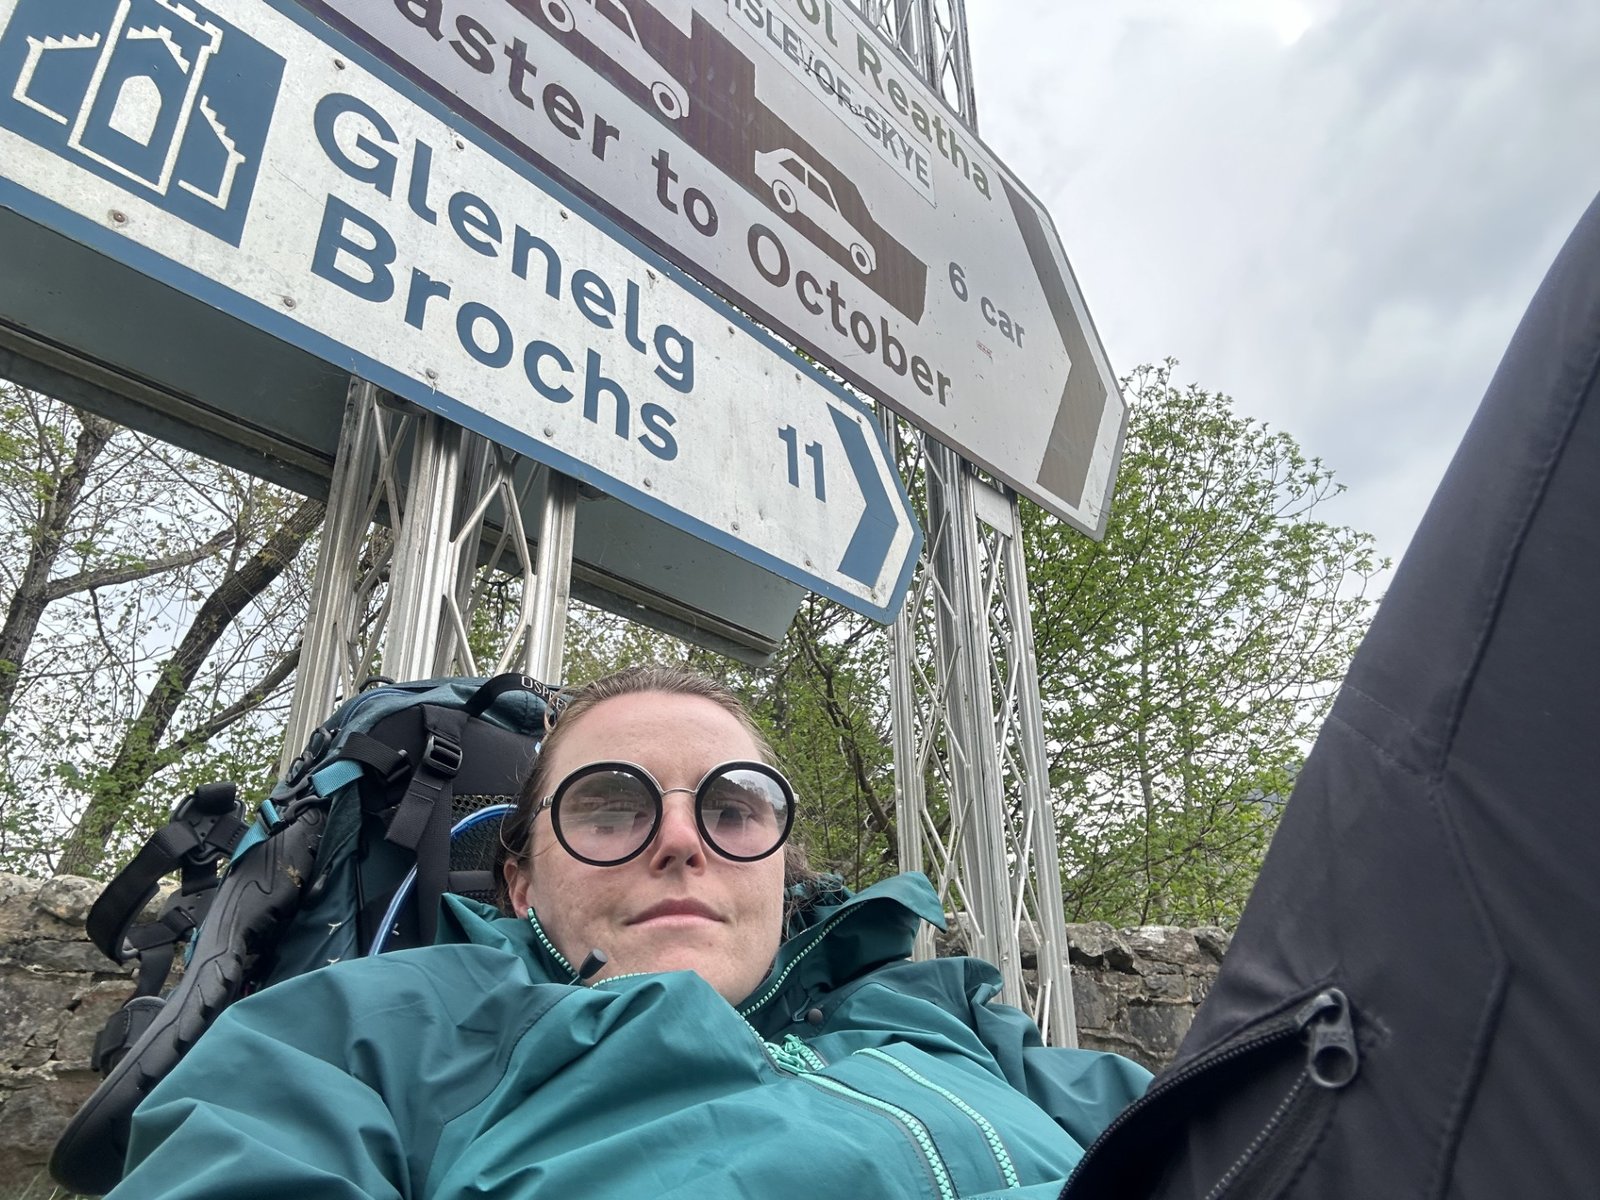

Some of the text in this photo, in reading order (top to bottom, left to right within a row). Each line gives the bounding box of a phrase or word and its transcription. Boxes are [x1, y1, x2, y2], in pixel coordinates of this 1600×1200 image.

[814, 59, 851, 108] OF
[864, 106, 930, 190] SKYE
[857, 33, 992, 201] Reatha
[310, 193, 827, 502] Brochs 11
[314, 93, 695, 394] Glenelg
[651, 149, 719, 238] to
[747, 223, 952, 408] October
[949, 261, 1025, 349] 6 car
